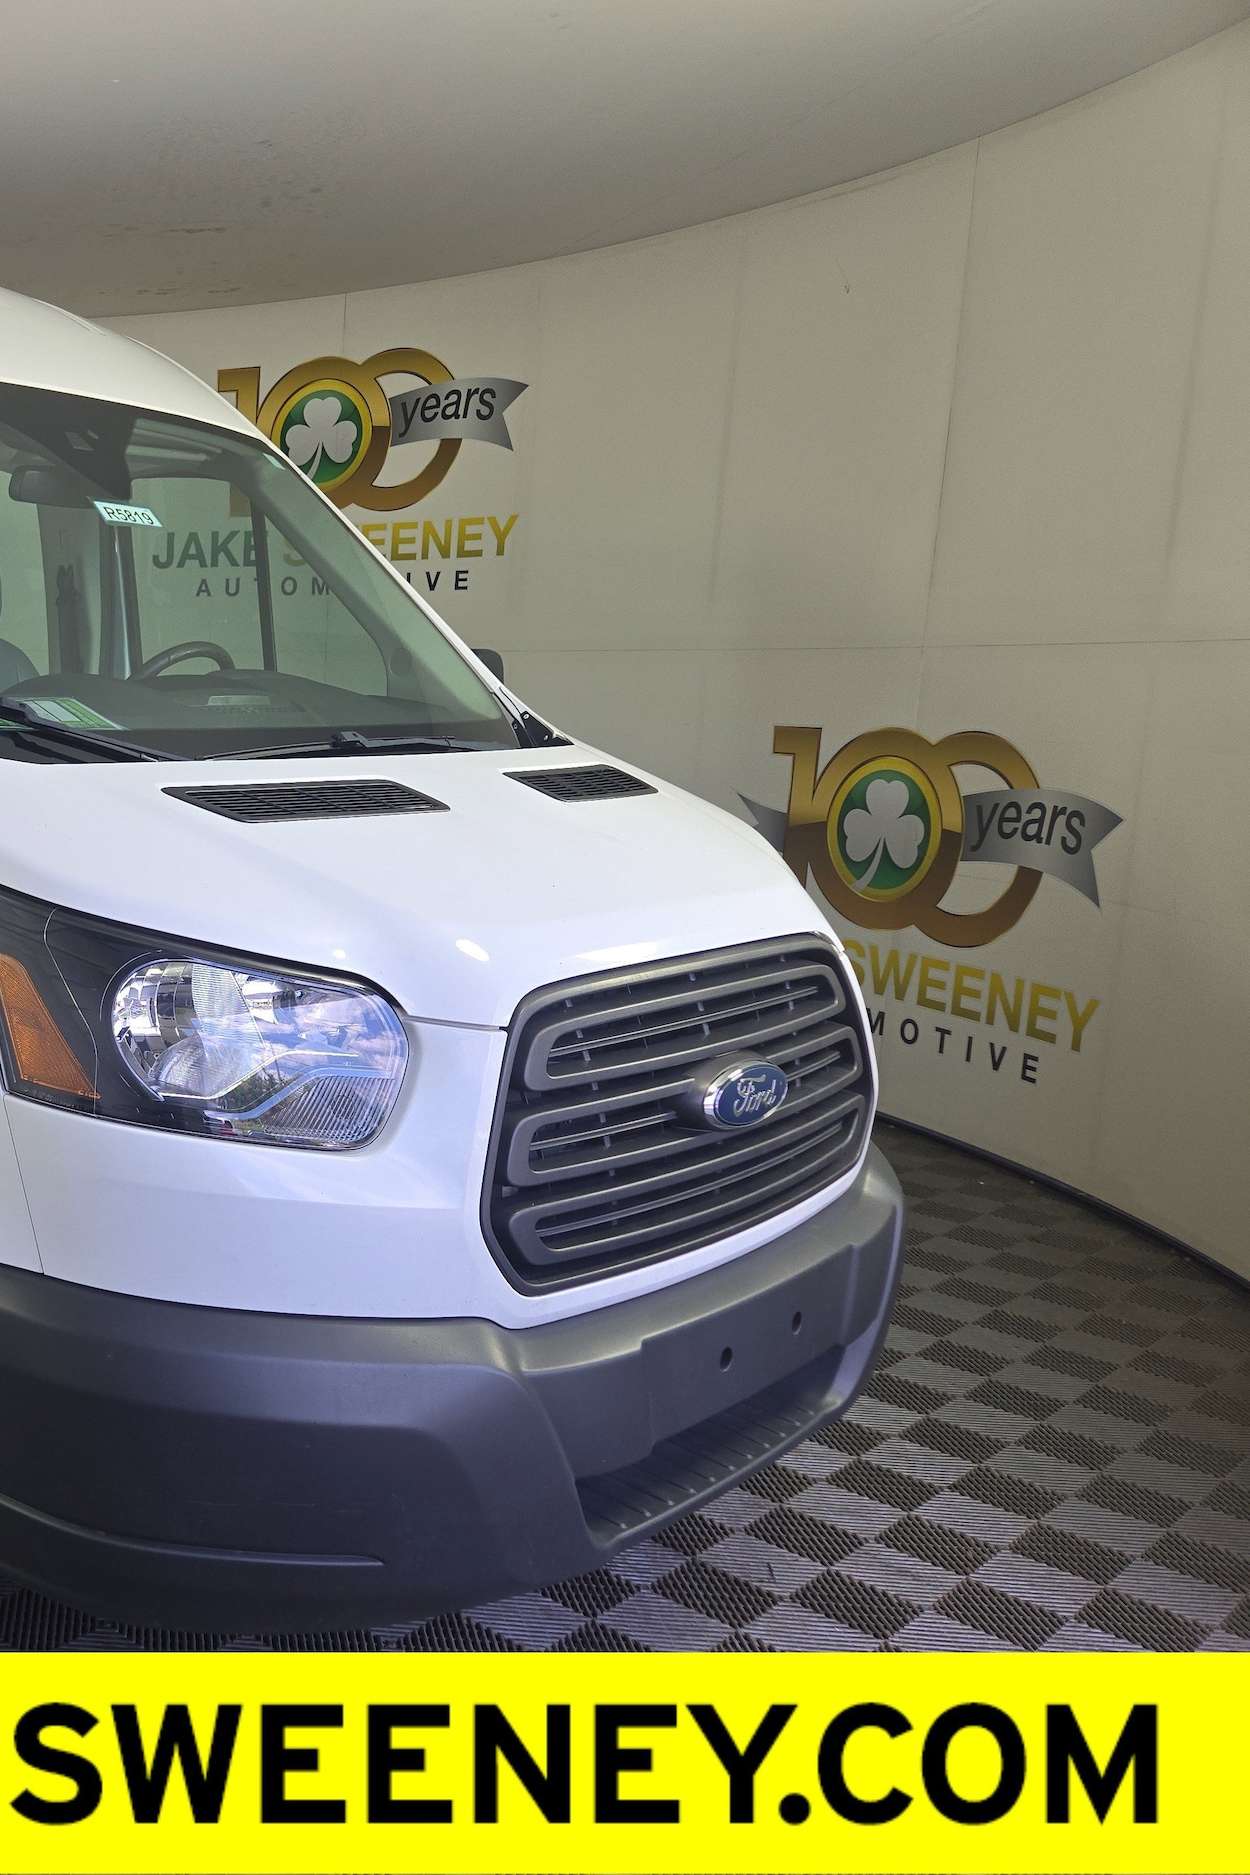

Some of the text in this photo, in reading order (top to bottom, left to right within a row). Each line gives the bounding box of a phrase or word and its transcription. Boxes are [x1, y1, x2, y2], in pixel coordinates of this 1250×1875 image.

[399, 387, 497, 438] years
[103, 506, 154, 525] R5819
[772, 725, 1049, 948] 100
[970, 800, 1086, 855] years
[842, 939, 1100, 1053] SWEENEY
[733, 1074, 777, 1118] Ford
